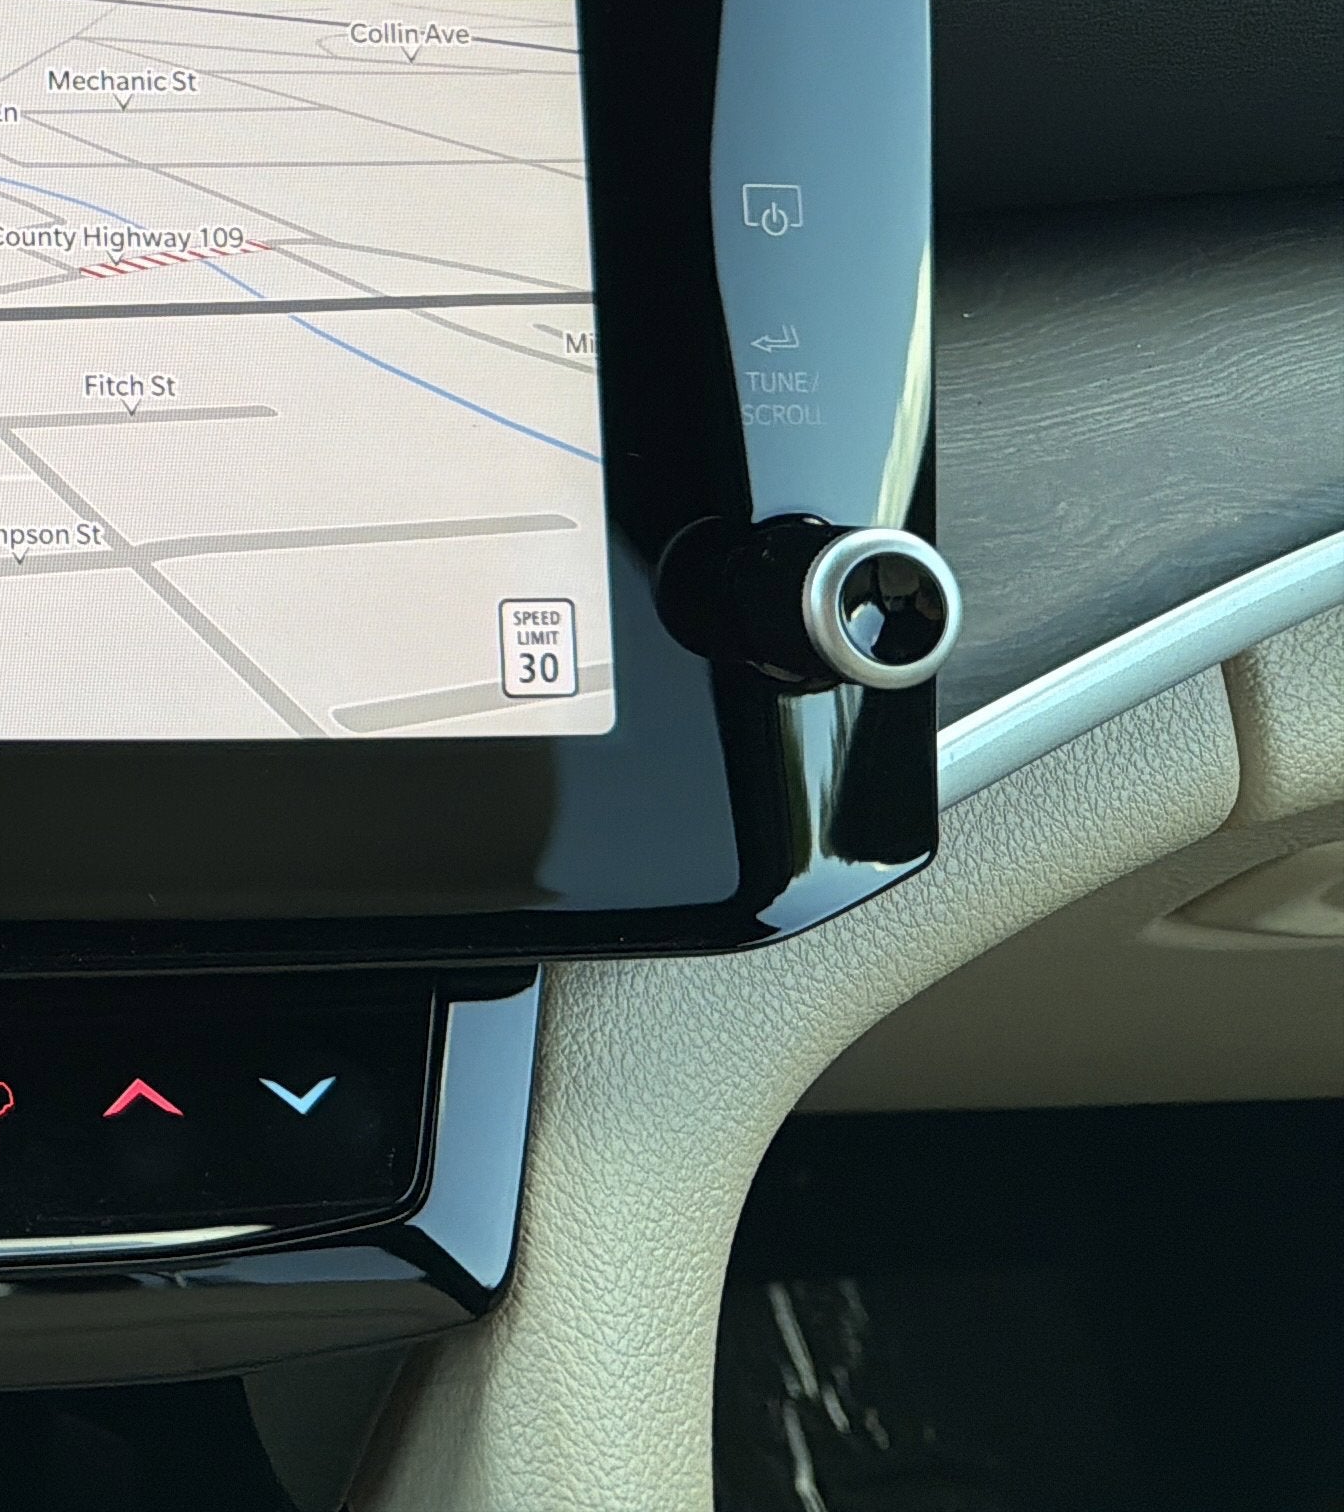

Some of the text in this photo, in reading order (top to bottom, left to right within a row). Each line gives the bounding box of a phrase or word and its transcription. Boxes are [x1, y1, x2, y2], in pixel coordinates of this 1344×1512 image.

[350, 21, 470, 45] Collin Ave
[48, 68, 197, 92] Mechanic St
[82, 224, 192, 254] Highway
[199, 226, 244, 248] 109
[566, 332, 594, 354] Mi
[85, 374, 175, 398] Fitch St
[76, 522, 101, 546] St
[513, 611, 561, 626] SPEED
[517, 631, 558, 646] LIMIT
[519, 655, 560, 682] 30
